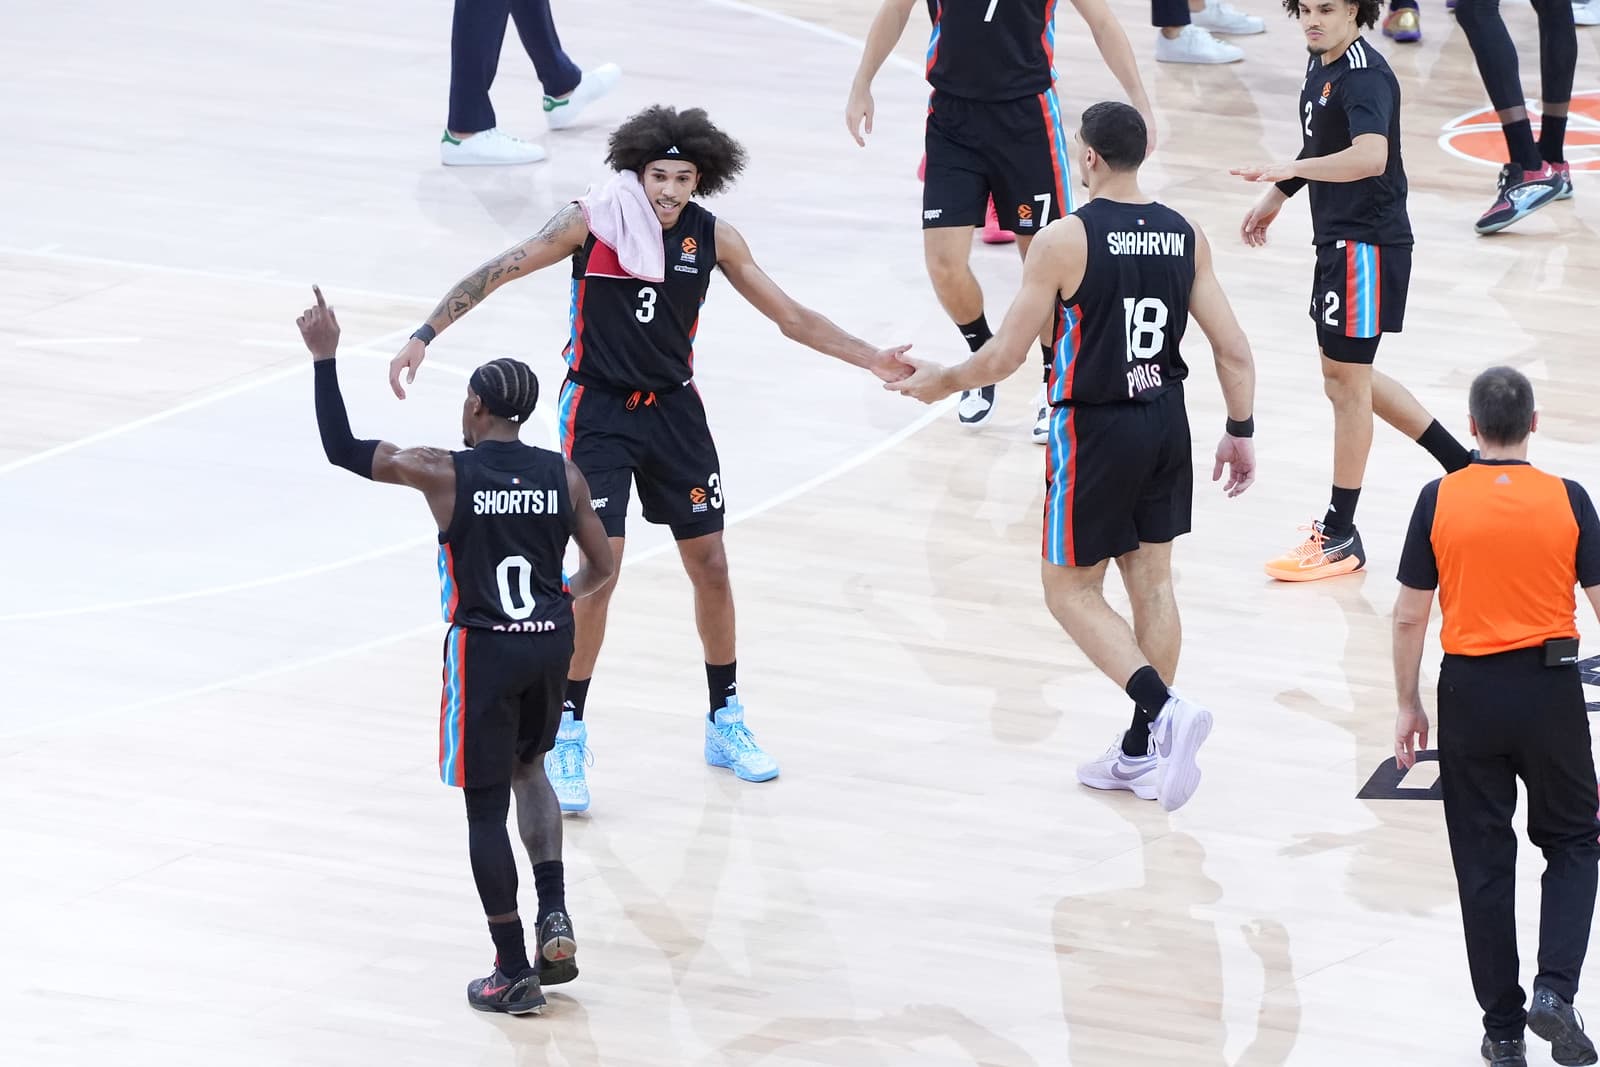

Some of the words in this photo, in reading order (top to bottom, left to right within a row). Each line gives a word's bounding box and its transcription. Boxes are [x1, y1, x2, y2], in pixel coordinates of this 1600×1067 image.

[1304, 100, 1313, 137] 2
[1033, 192, 1052, 228] 7
[1106, 231, 1186, 257] SHAHRVIN
[635, 286, 657, 323] 3
[1123, 297, 1169, 363] 18
[1126, 363, 1162, 398] PARIS
[473, 489, 540, 515] SHORTS
[547, 489, 558, 515] II
[707, 472, 723, 510] 3
[496, 555, 536, 621] 0
